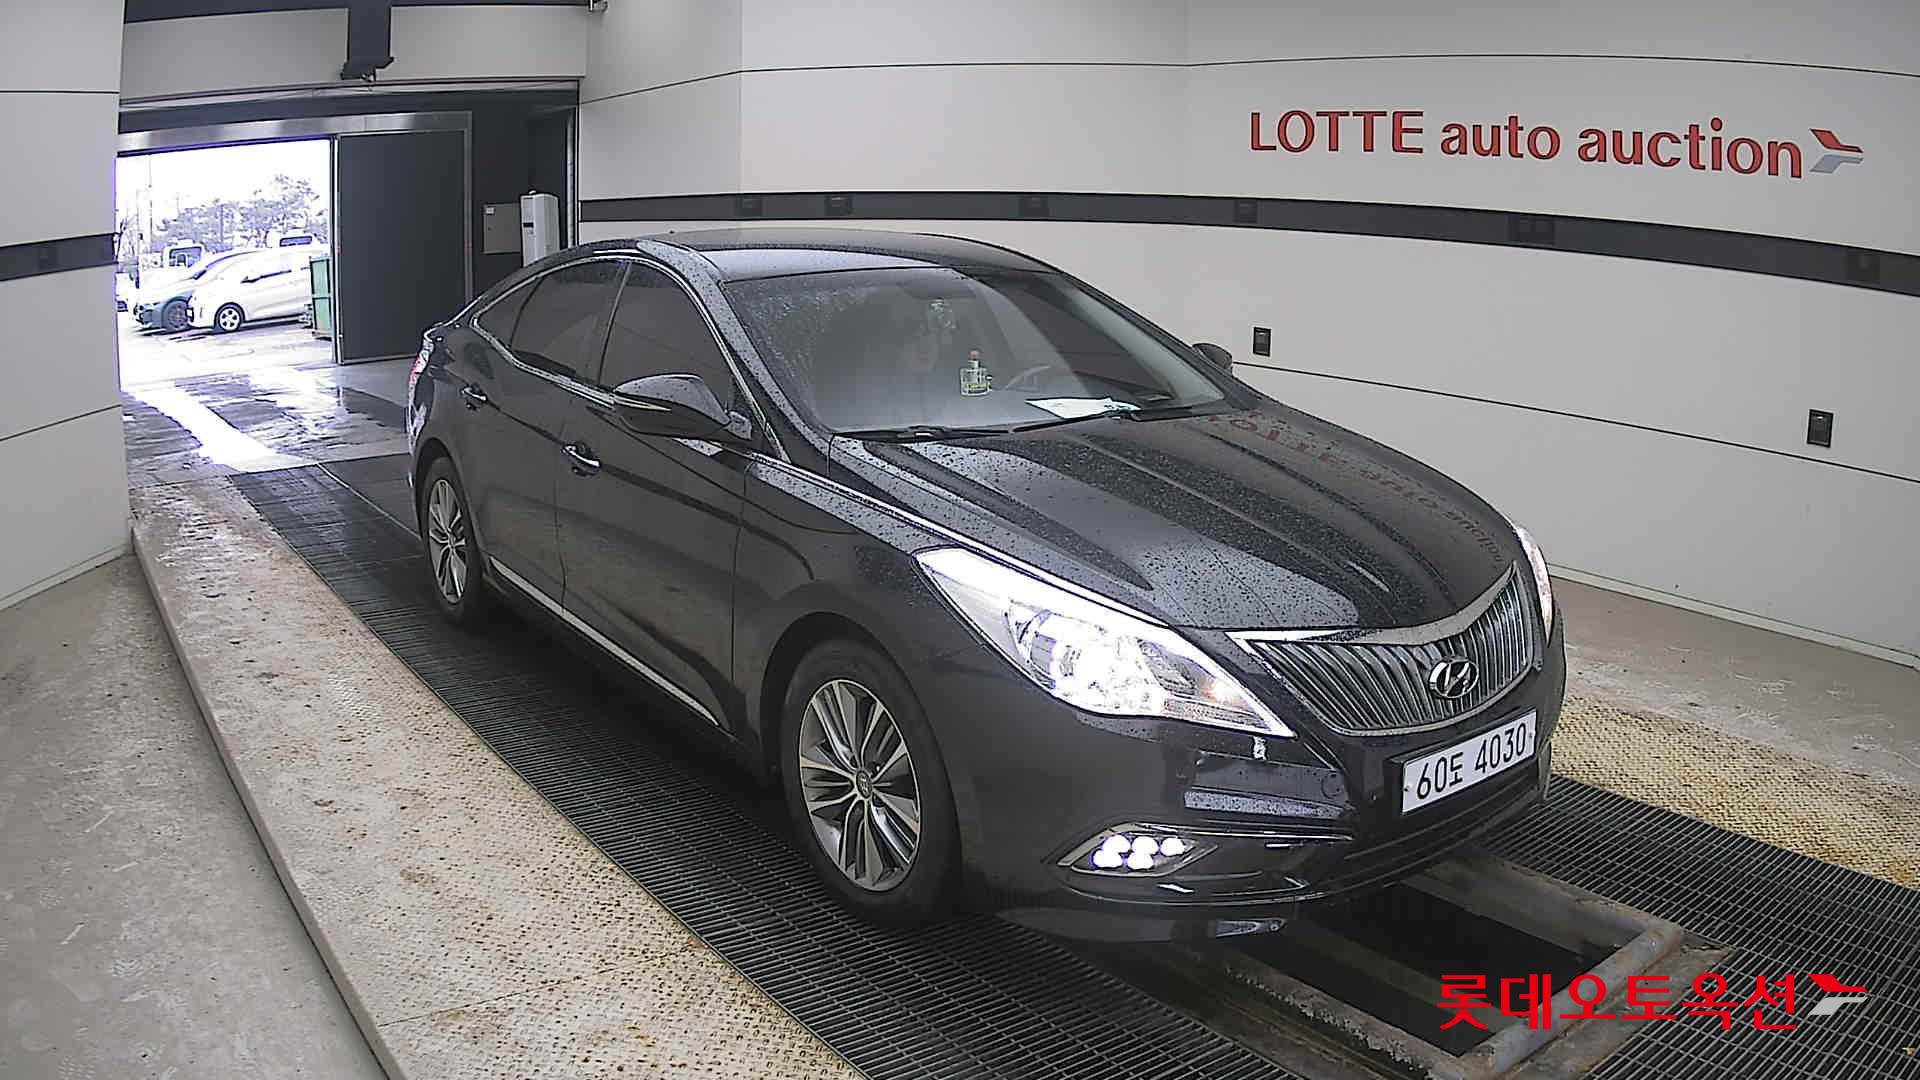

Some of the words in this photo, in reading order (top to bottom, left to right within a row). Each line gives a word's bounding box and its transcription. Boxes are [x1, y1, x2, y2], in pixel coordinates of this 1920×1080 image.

[1250, 110, 1424, 154] LOTTE
[1440, 115, 1561, 160] auto
[1577, 117, 1803, 179] auction
[1416, 751, 1464, 800] 60도
[1474, 722, 1527, 774] 4030
